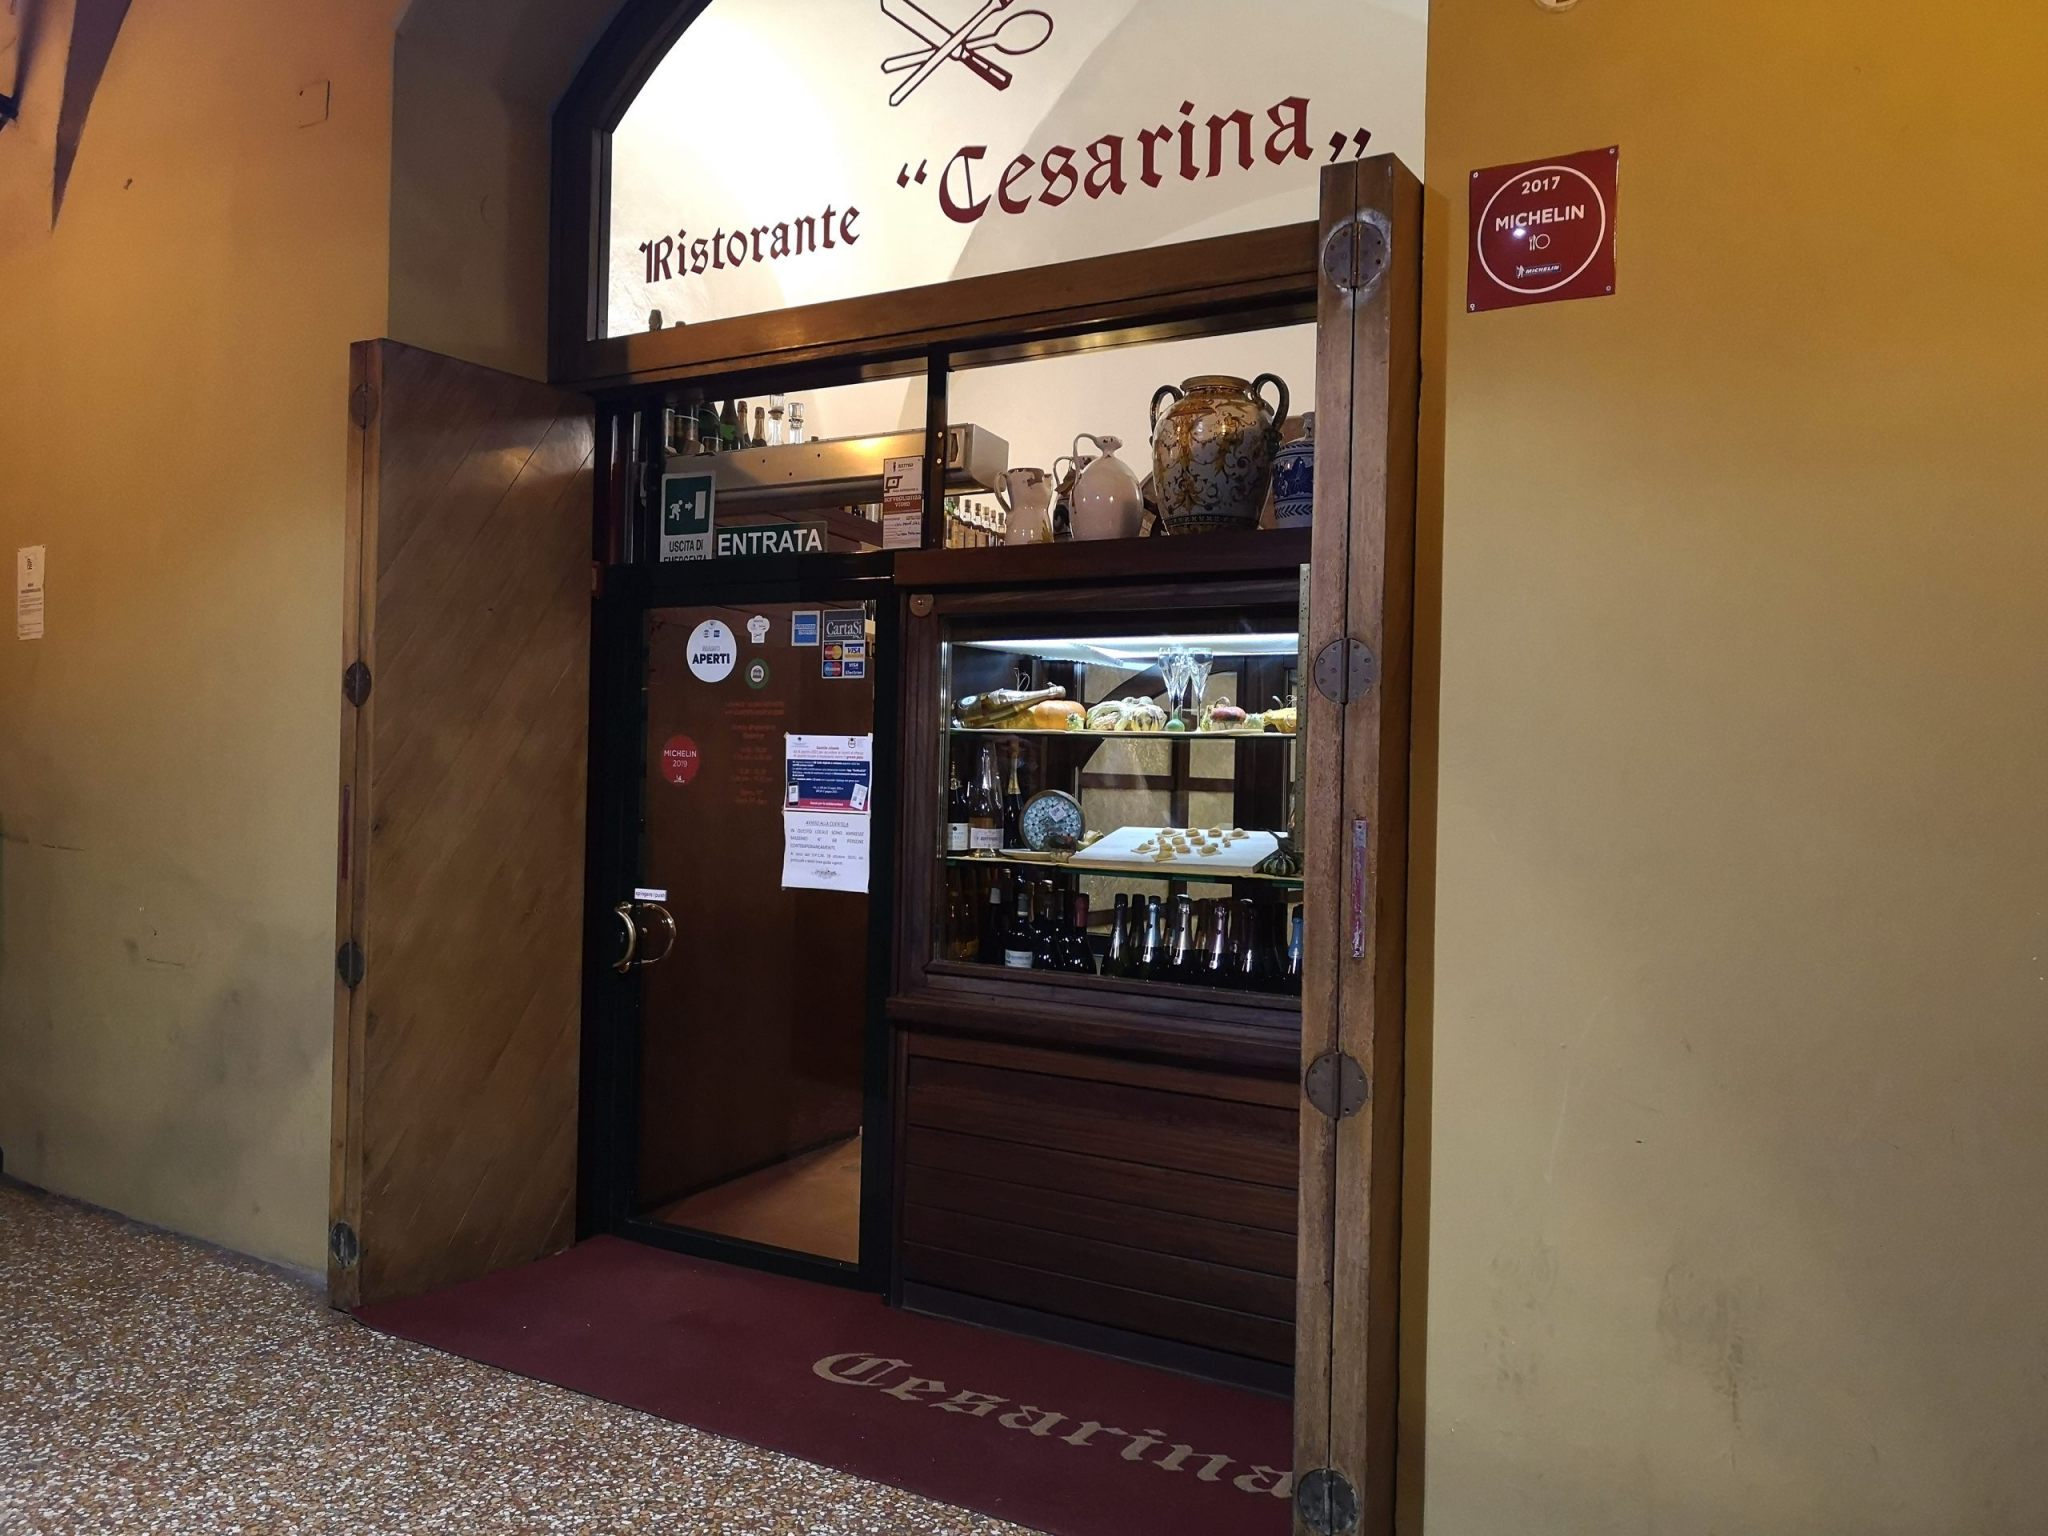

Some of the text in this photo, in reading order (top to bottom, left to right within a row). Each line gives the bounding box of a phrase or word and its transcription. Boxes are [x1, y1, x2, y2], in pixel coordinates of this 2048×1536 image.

[1521, 175, 1561, 195] 2017
[1495, 204, 1585, 232] MICHELIN
[640, 203, 860, 284] Ristorante
[1525, 264, 1560, 274] MICHELIN
[669, 539, 704, 553] USCITA DI
[717, 528, 823, 557] ENTRATA
[692, 653, 730, 664] APERTI
[663, 750, 697, 758] MICHELIN
[812, 1352, 1294, 1499] Cesarina
